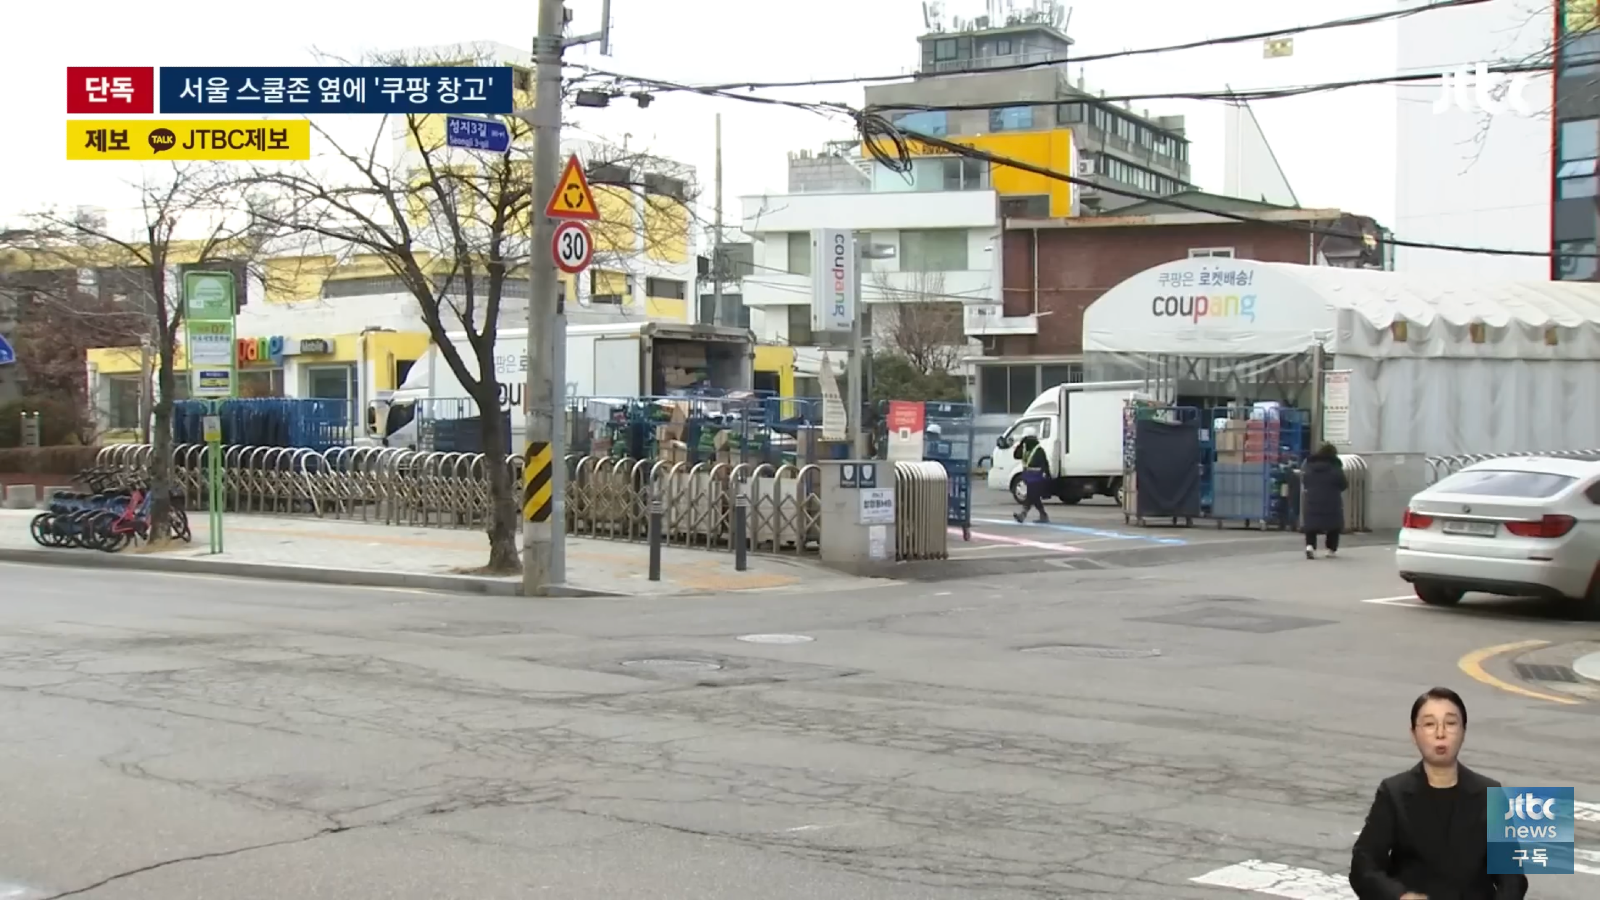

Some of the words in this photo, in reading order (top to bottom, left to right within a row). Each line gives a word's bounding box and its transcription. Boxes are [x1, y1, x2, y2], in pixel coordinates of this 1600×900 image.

[449, 119, 487, 137] 성지3길
[562, 232, 584, 260] 30
[831, 233, 845, 317] coupang
[1157, 272, 1193, 287] 쿠팡은
[1198, 266, 1254, 287] 로켓배송!
[1152, 293, 1256, 323] coupang
[237, 335, 284, 368] pang
